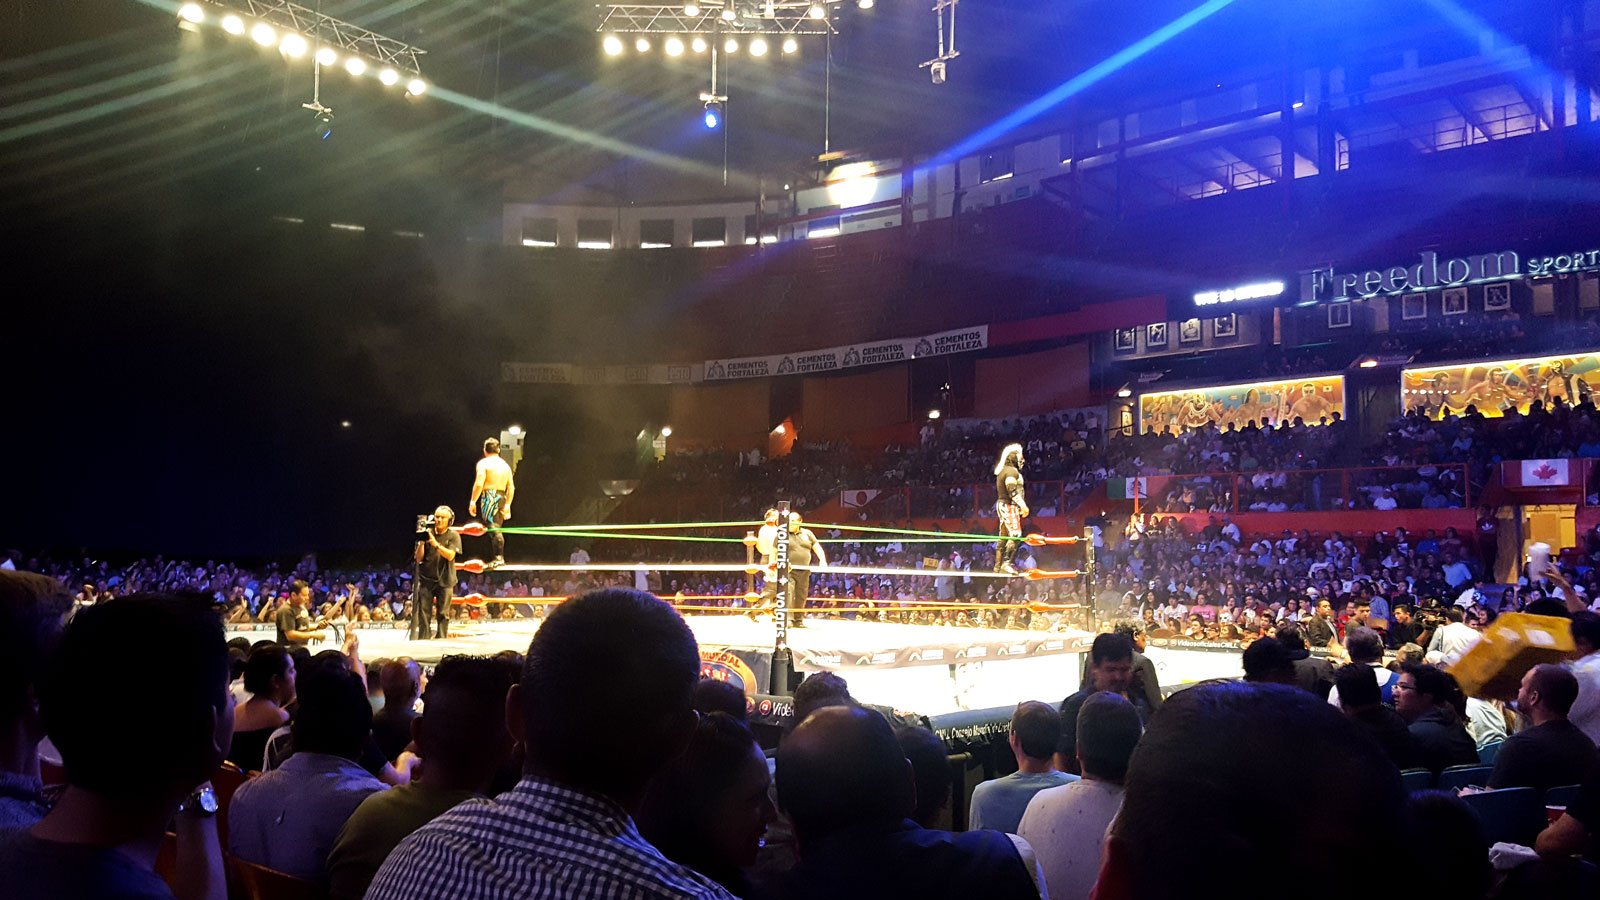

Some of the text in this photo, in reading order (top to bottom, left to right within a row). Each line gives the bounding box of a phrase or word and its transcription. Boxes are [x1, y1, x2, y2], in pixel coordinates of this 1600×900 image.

[1300, 250, 1520, 300] Freedom
[1527, 249, 1600, 274] SPORT
[935, 331, 980, 346] CEMENTOS
[862, 344, 903, 356] CEMENTOS
[935, 340, 982, 354] FORTALEZA
[797, 353, 836, 364] CEMENTOS
[862, 352, 905, 364] FORTALEZA
[727, 361, 768, 370] CEMENTOS
[727, 367, 769, 377] FORTALEZA
[797, 361, 837, 372] FORTALEZA
[777, 523, 790, 569] volaris
[776, 591, 788, 638] volaris
[772, 701, 794, 717] Vide
